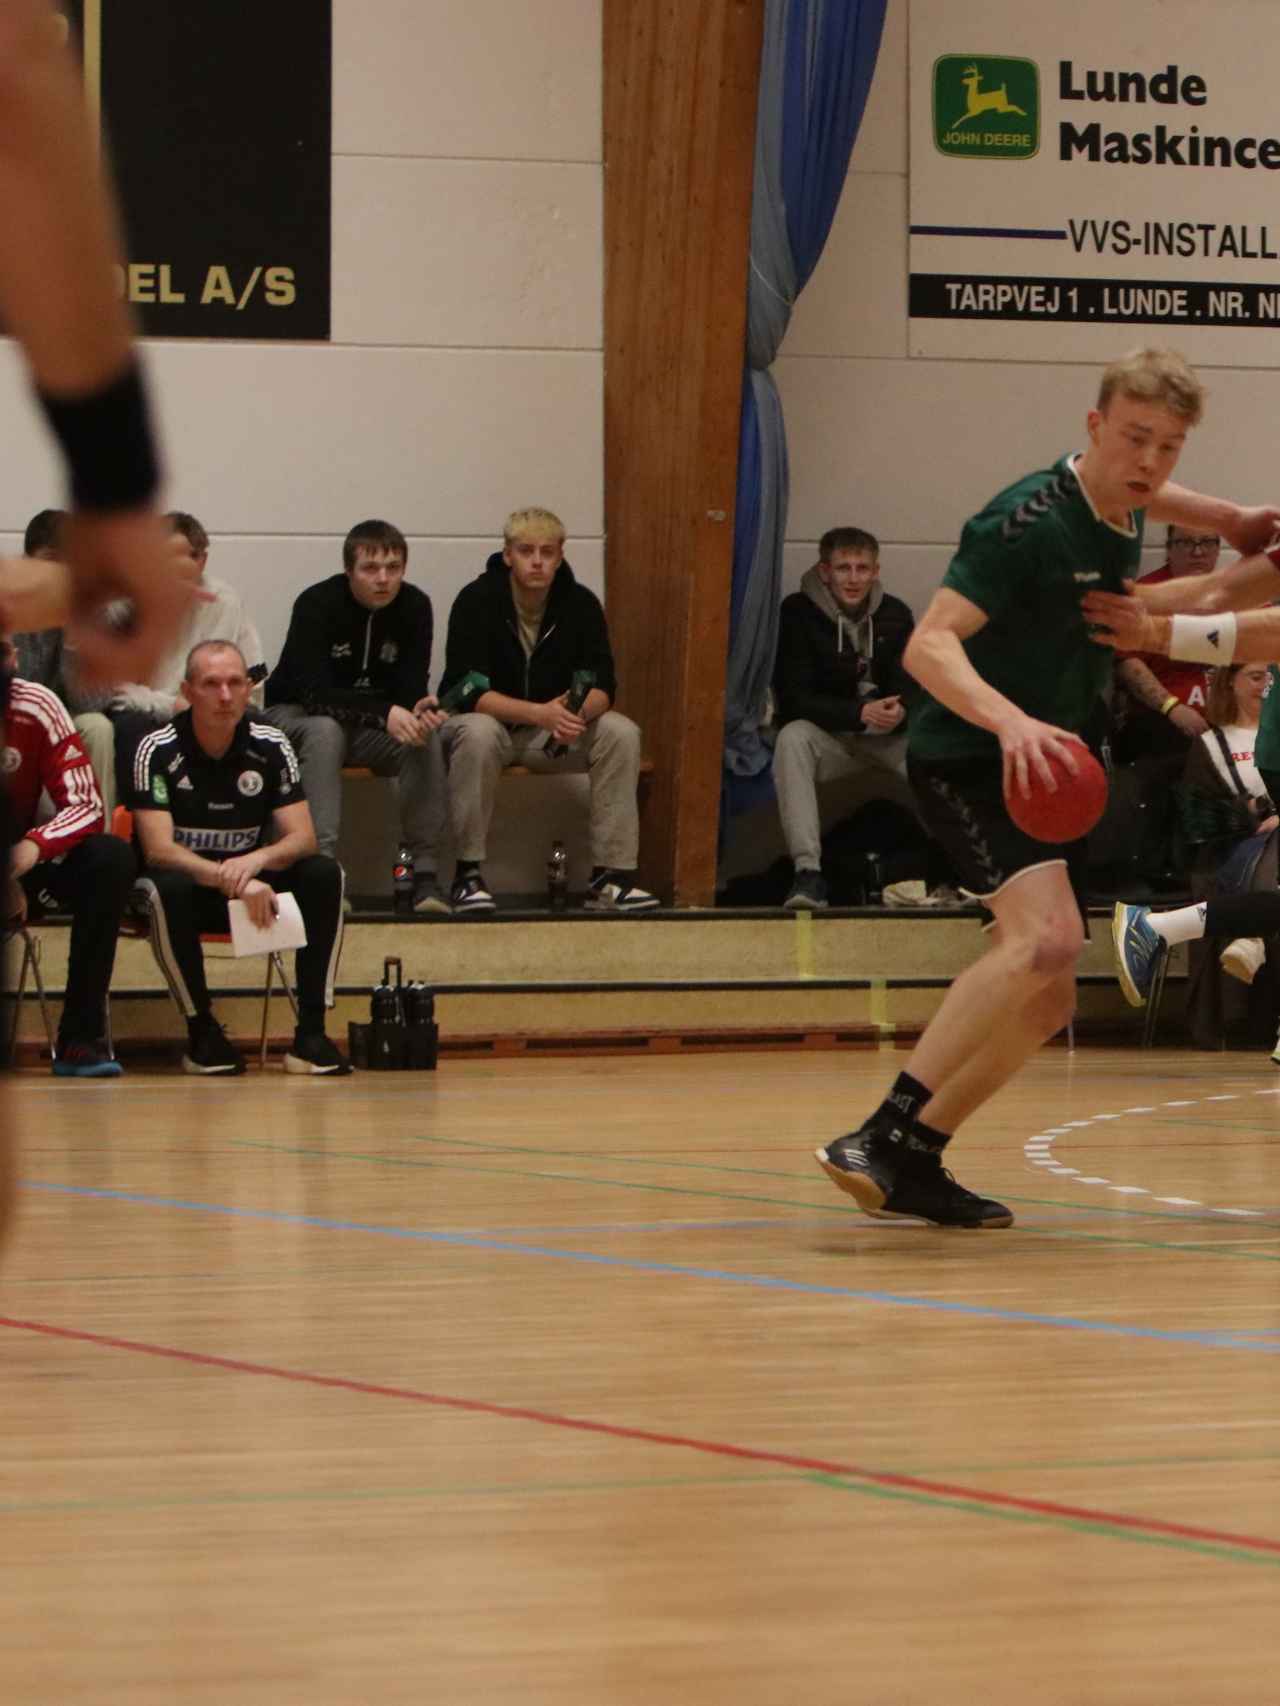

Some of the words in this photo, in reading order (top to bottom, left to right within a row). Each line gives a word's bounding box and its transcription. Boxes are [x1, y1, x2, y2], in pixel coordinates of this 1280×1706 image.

[1059, 60, 1208, 106] Lunde
[942, 130, 981, 146] JOHN
[984, 133, 1032, 148] DEERE
[114, 263, 186, 304] EL
[200, 264, 297, 311] A/S
[946, 283, 1060, 314] TARPVEJ
[1103, 287, 1188, 317] LUNDE
[1208, 291, 1250, 318] NR.
[175, 831, 256, 849] PHILIPS
